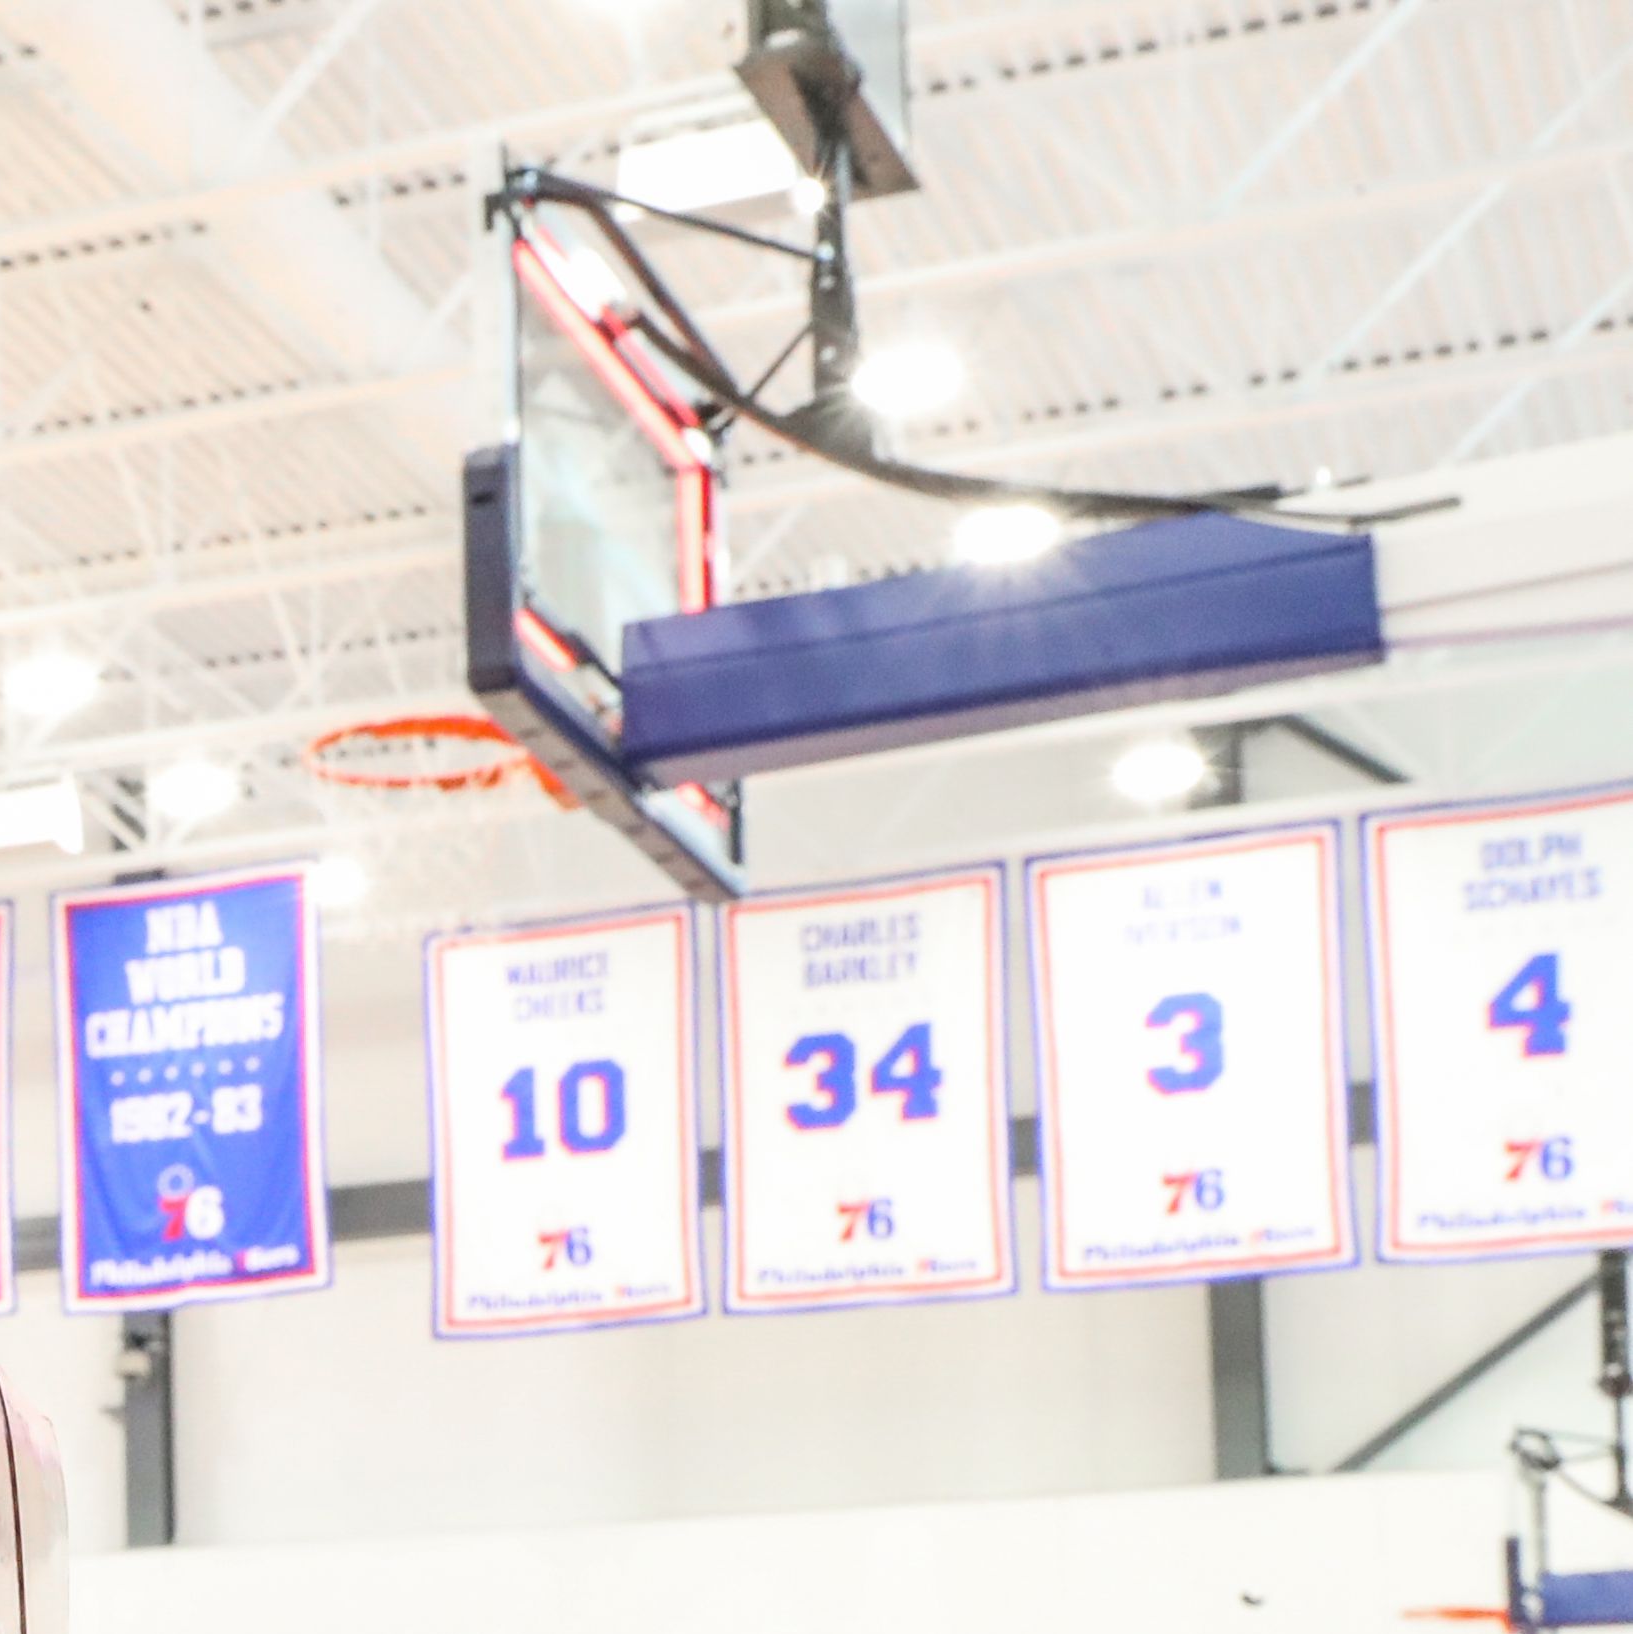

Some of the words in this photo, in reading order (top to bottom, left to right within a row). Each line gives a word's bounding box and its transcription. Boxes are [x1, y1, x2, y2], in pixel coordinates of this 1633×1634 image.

[145, 901, 224, 954] NBA
[123, 946, 246, 1000] WORLD
[84, 992, 285, 1060] CHAMPIONS
[1486, 952, 1572, 1060] 4
[1144, 991, 1225, 1096] 3
[783, 1020, 944, 1132] 34
[501, 1057, 627, 1163] 10
[1503, 1135, 1574, 1184] 76
[158, 1184, 226, 1242] 76
[835, 1197, 896, 1243] 76
[1160, 1167, 1226, 1217] 76
[537, 1225, 594, 1271] 76
